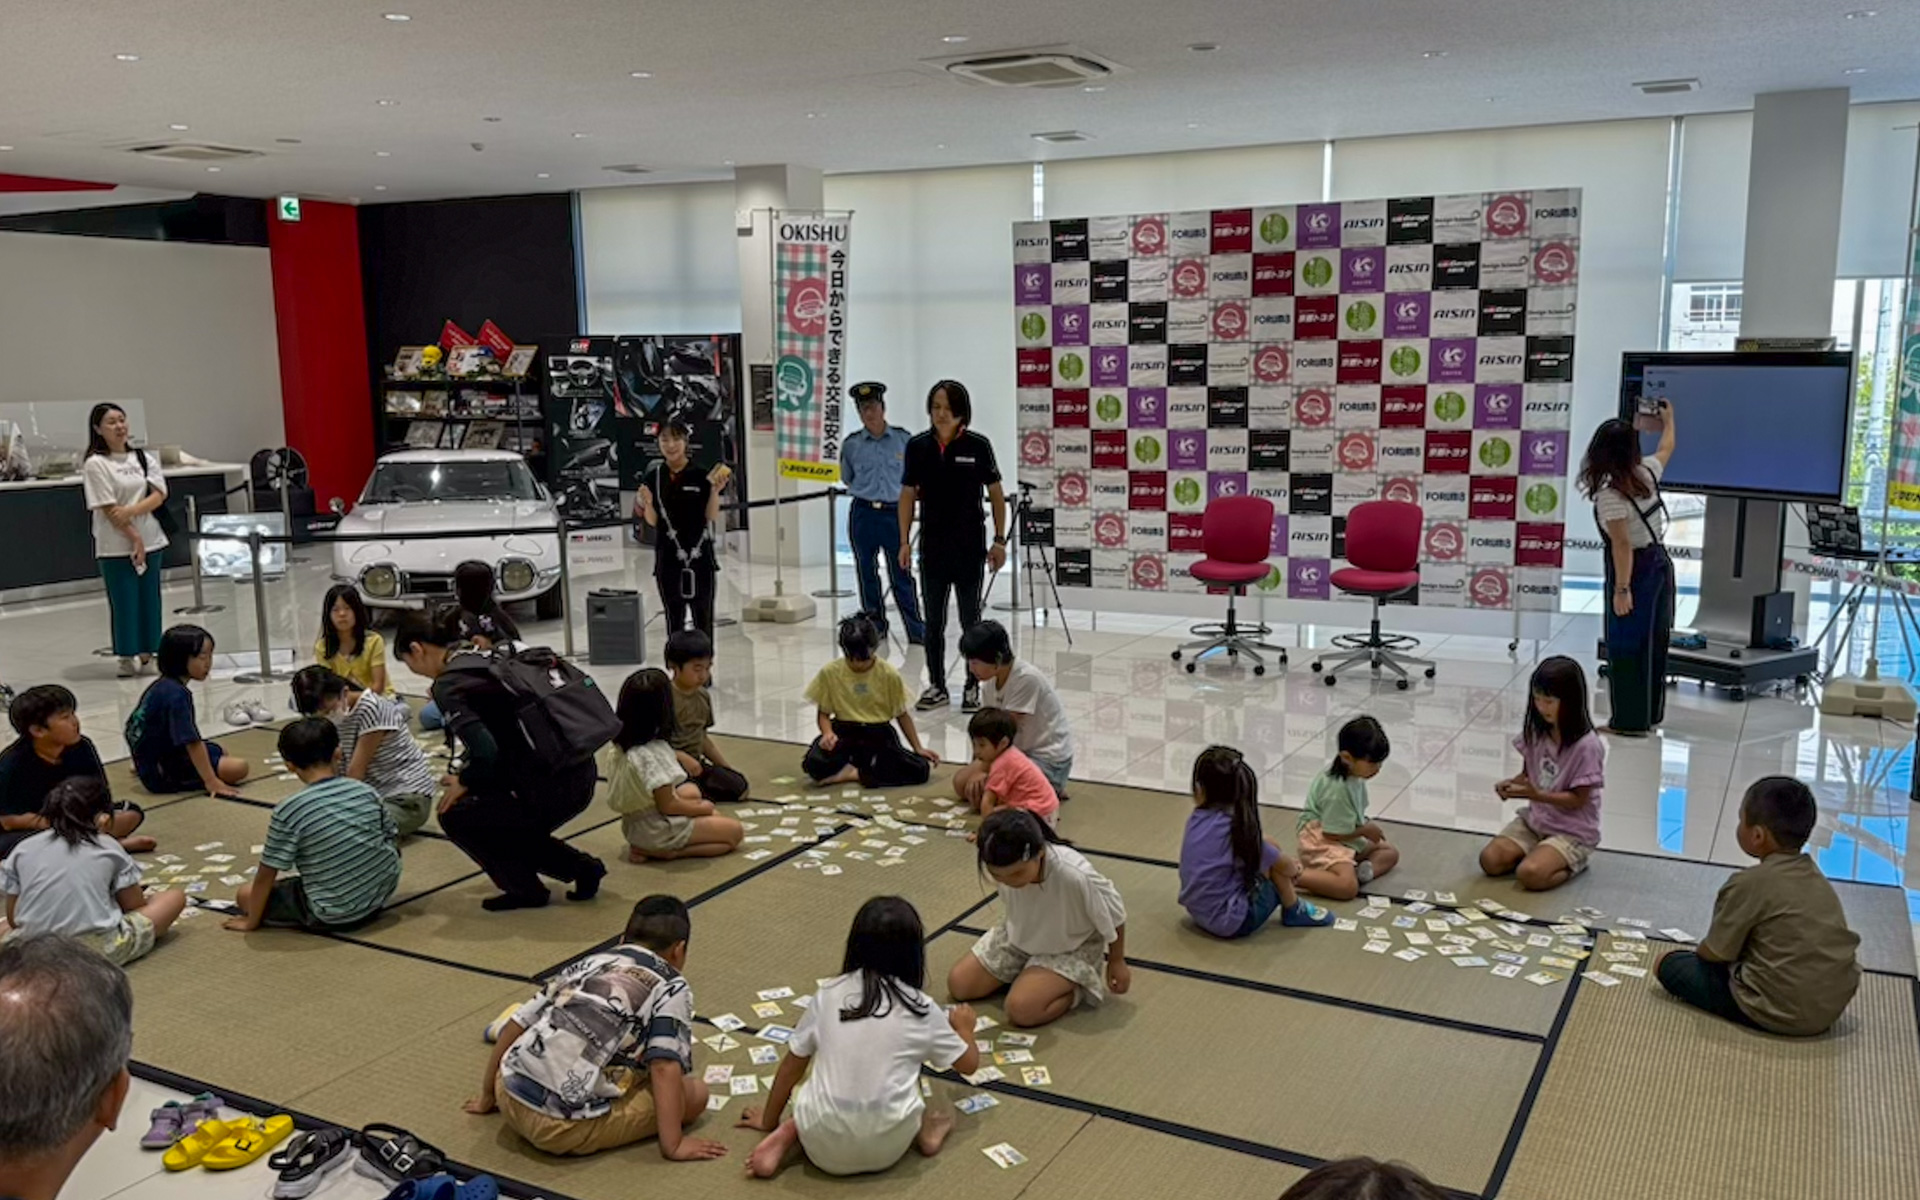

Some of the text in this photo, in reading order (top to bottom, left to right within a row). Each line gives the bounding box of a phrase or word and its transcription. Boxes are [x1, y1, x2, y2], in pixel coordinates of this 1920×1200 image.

[1344, 219, 1384, 228] AISIN
[780, 223, 848, 242] OKISHU
[1389, 264, 1429, 273] AISIN
[1434, 309, 1475, 318] AISIN
[823, 250, 846, 460] 今日からできる交通安全
[1480, 356, 1522, 364] AISIN
[1526, 403, 1569, 411] AISIN
[788, 464, 834, 476] DUNLOP
[1292, 533, 1328, 541] AISIN
[1565, 538, 1607, 551] OHAMA
